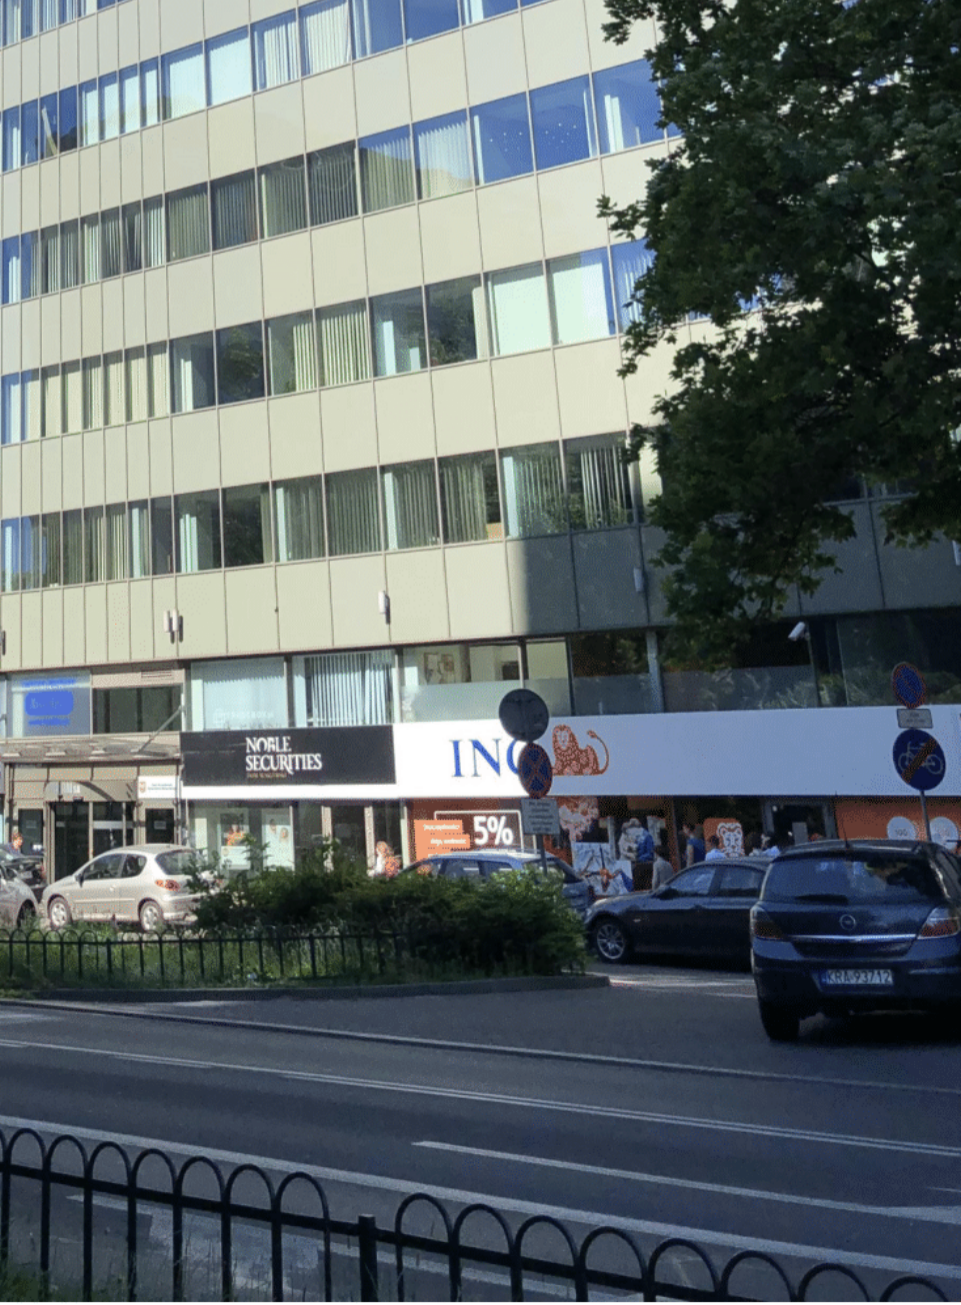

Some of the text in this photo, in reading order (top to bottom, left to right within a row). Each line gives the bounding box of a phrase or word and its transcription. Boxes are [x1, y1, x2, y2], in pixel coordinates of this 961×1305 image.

[245, 736, 292, 753] NOBLE
[245, 753, 323, 775] SECURITIES
[473, 815, 514, 846] 5%
